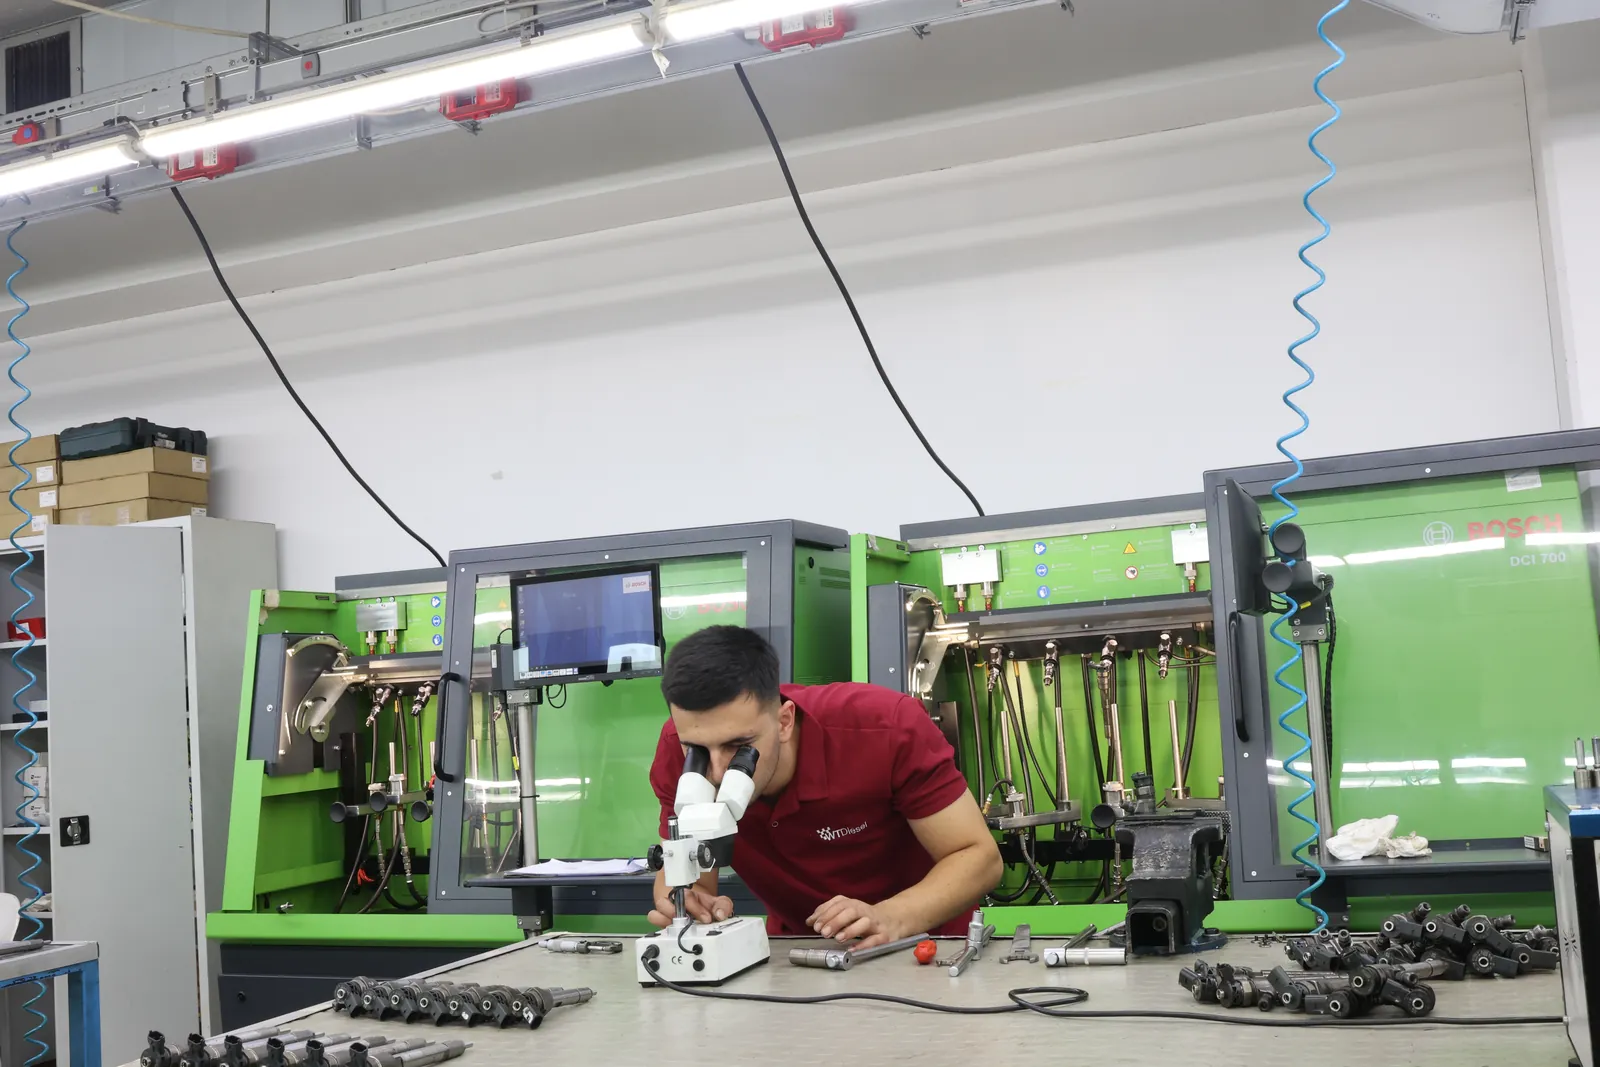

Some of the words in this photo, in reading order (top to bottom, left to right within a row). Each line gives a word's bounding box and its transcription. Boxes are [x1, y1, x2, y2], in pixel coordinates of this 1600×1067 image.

[1467, 513, 1563, 541] BOSCH
[1510, 554, 1536, 567] DCI
[1540, 552, 1566, 564] 700
[671, 955, 683, 965] CE
